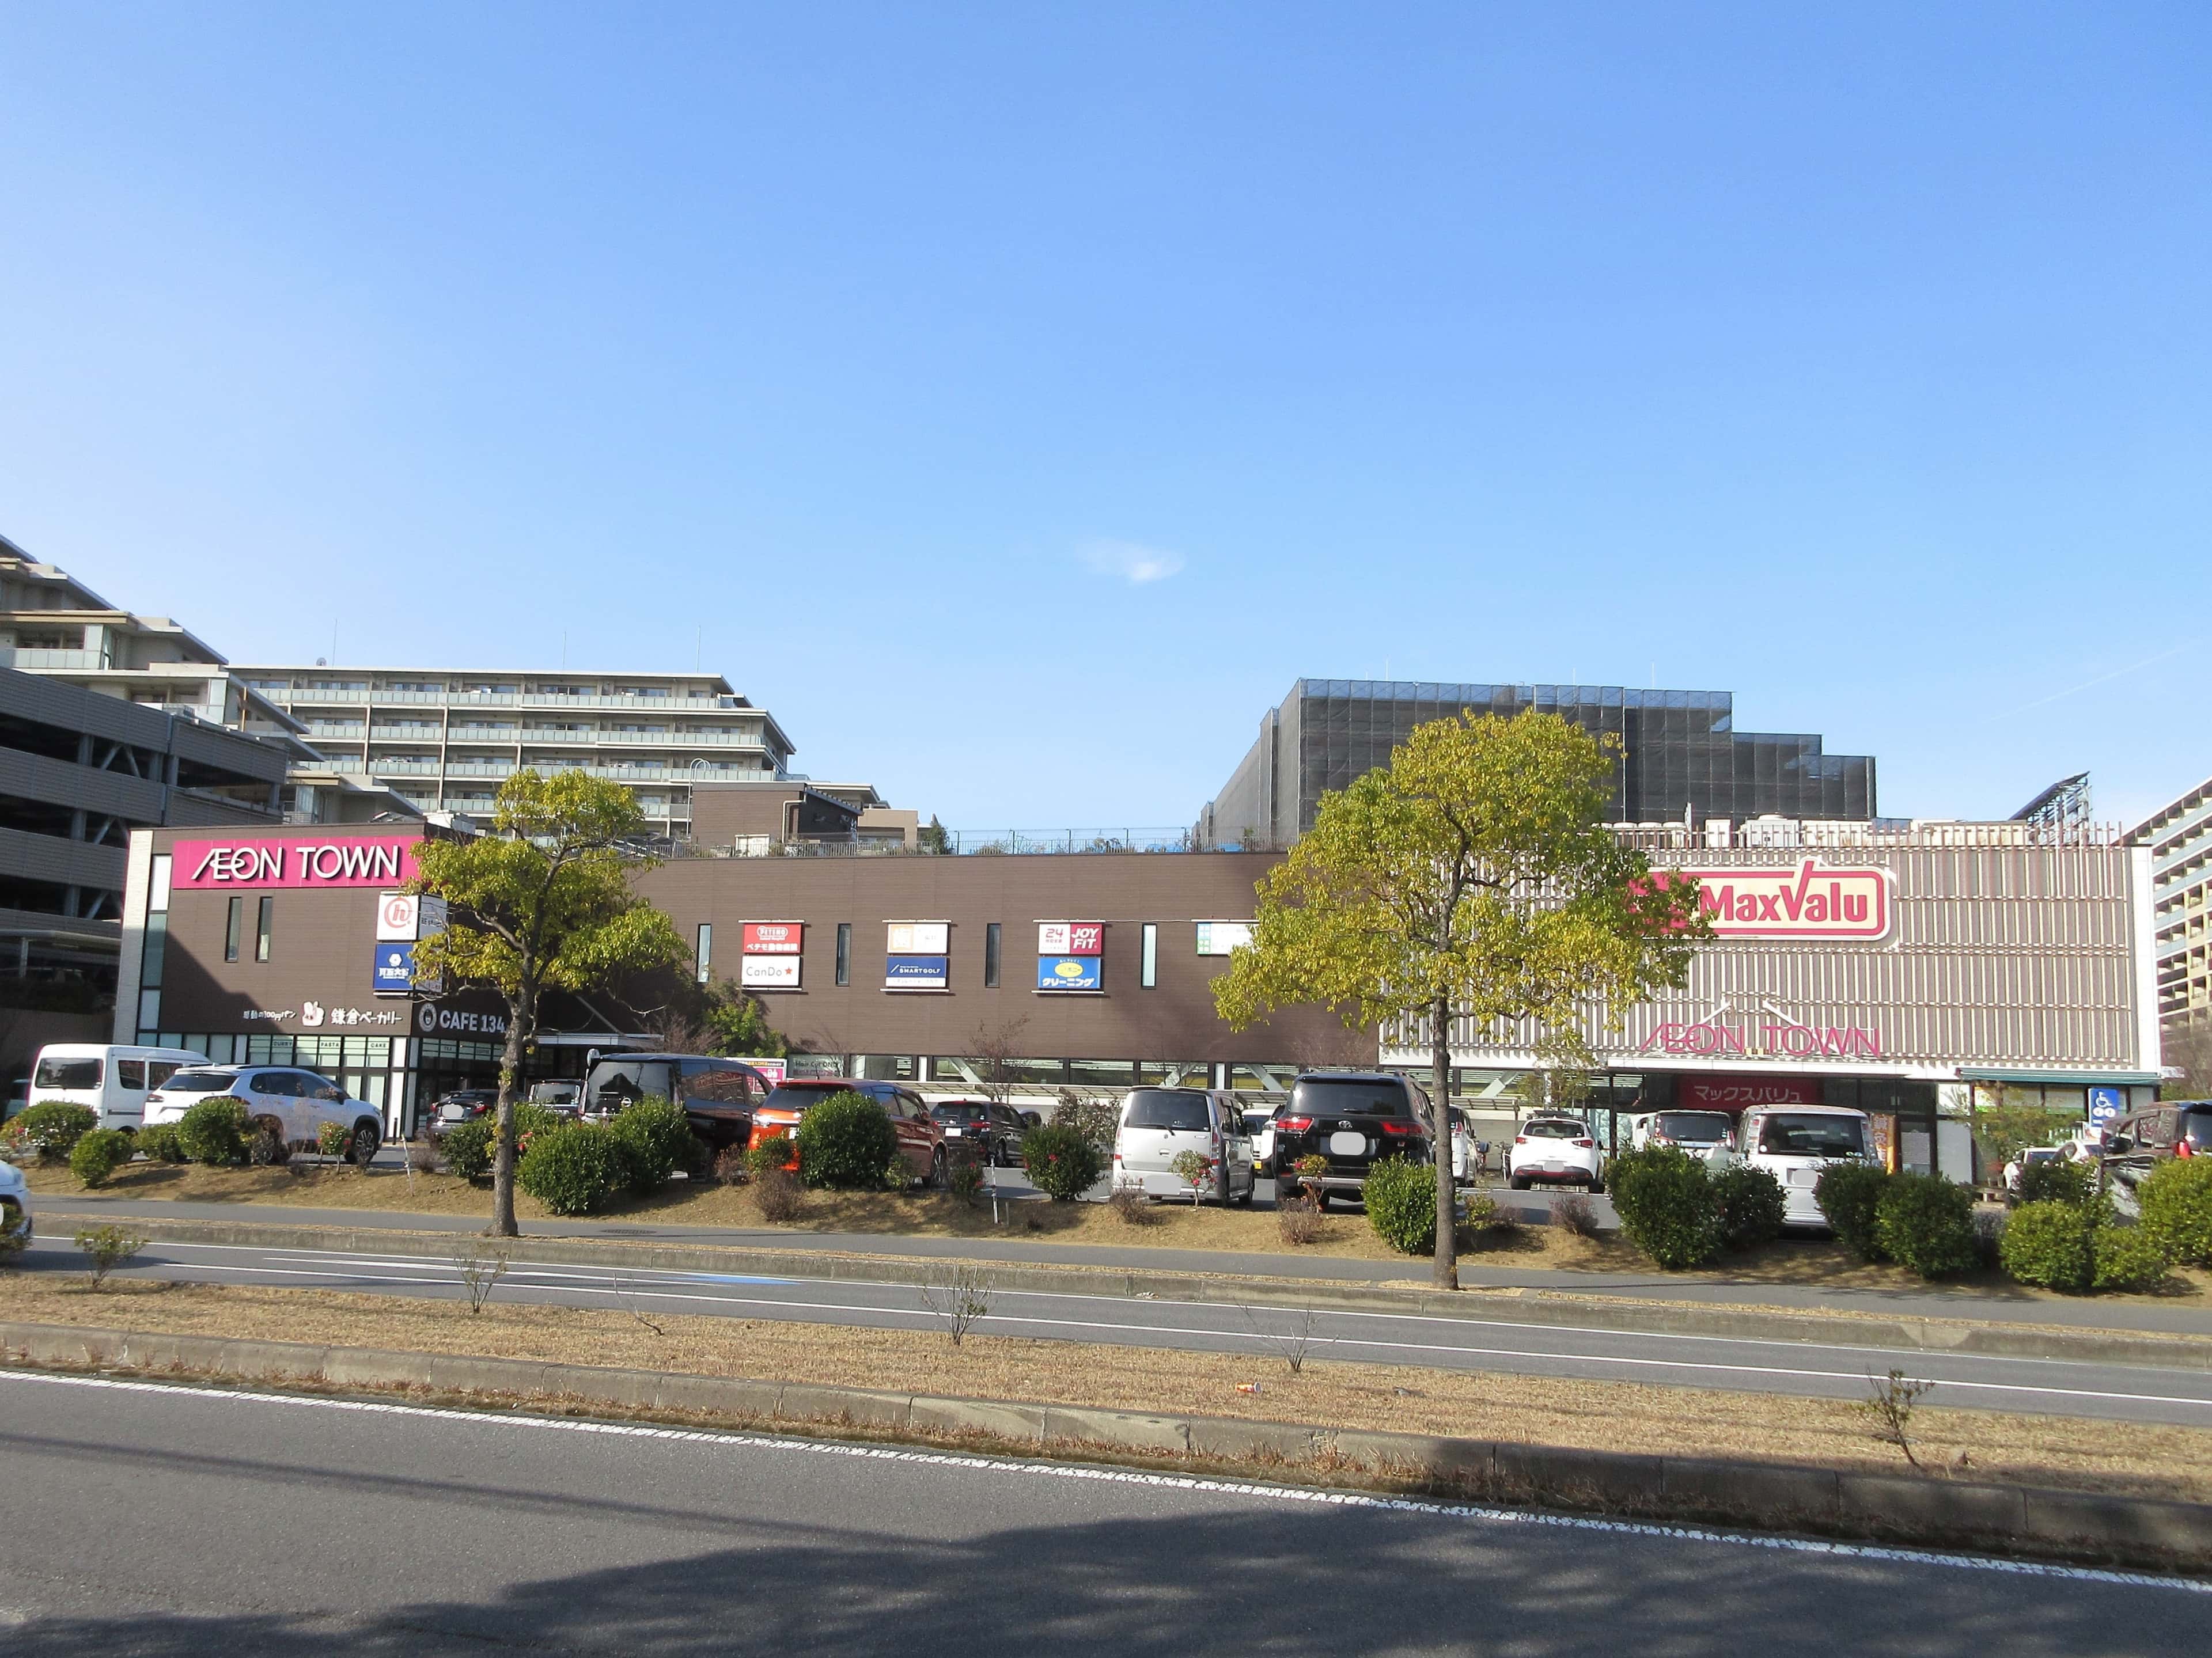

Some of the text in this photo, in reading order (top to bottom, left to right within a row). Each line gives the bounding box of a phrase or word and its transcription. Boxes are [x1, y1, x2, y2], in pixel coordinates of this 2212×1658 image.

[296, 845, 399, 879] TOWN
[1700, 860, 1868, 923] MaxValu
[1046, 928, 1063, 938] 24
[1071, 928, 1100, 939] JOY
[1073, 939, 1096, 949] FIT
[746, 966, 782, 977] CanDo
[1041, 977, 1095, 987] クリーニング
[331, 1008, 402, 1025] 鎌倉ベーカリー
[440, 1010, 478, 1032] CAFE
[1760, 1025, 1881, 1057] TOWN
[1694, 1085, 1803, 1104] マックスバリュ
